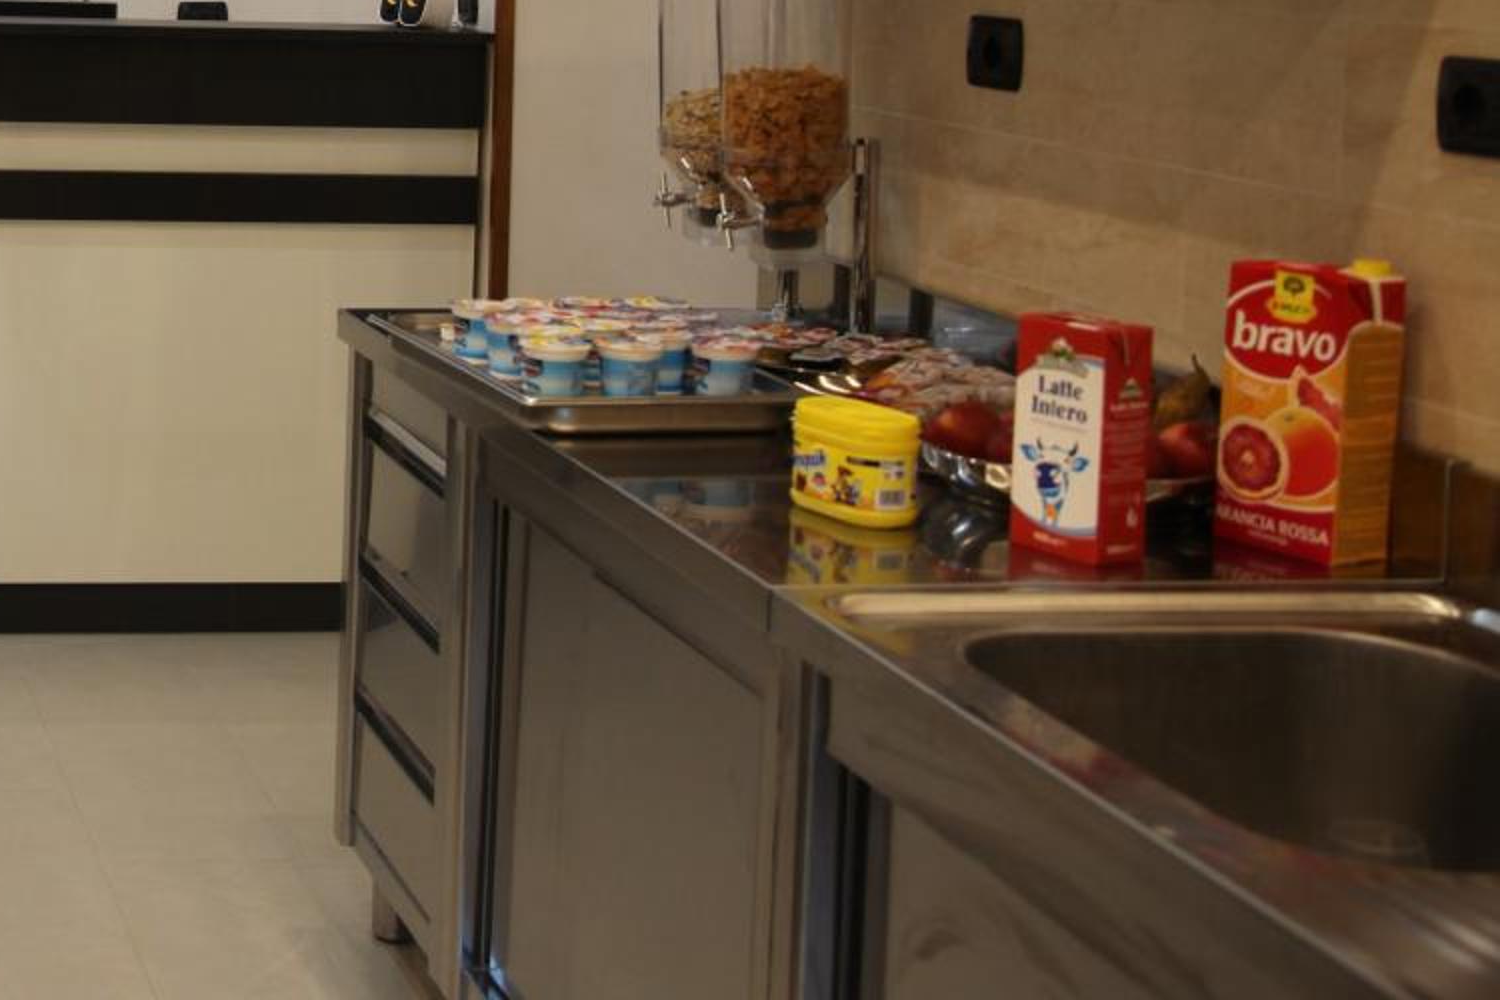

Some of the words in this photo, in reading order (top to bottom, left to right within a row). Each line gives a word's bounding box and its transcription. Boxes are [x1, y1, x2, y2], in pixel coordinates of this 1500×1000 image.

[1232, 309, 1337, 362] bravo
[1038, 375, 1084, 401] Latte
[1031, 395, 1088, 423] Intero
[1278, 520, 1329, 546] ROSSA
